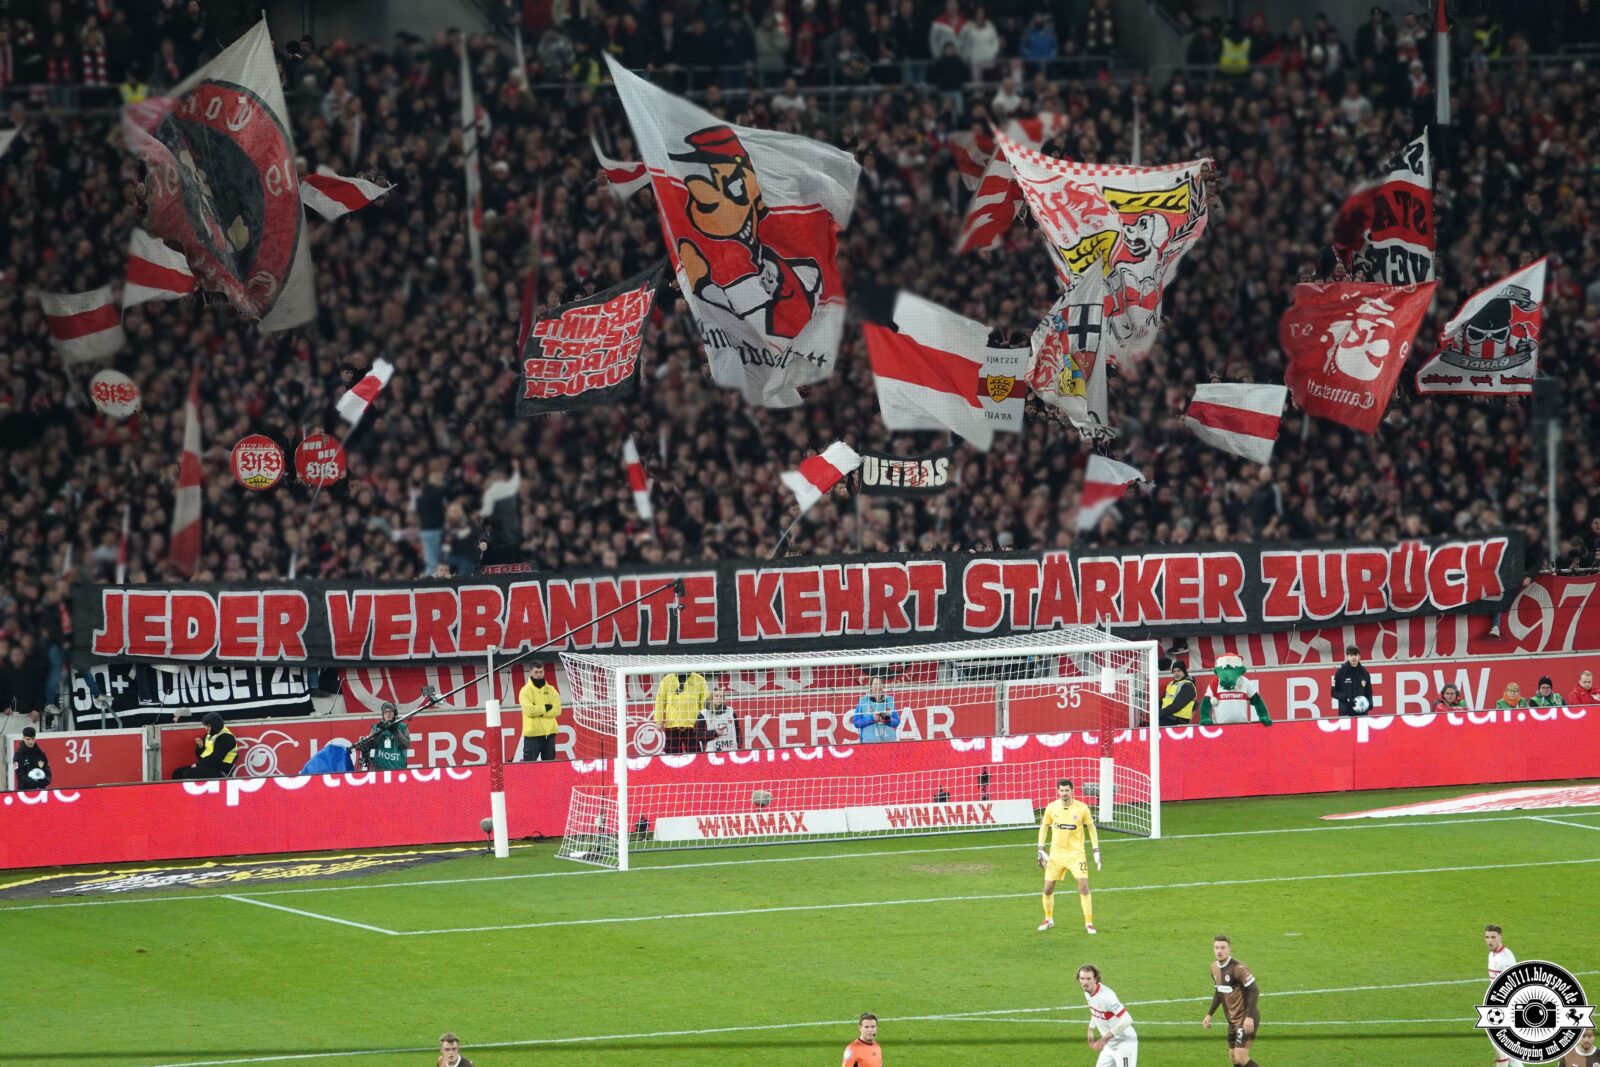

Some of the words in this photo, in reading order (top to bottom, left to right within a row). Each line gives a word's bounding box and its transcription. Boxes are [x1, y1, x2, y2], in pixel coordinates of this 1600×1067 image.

[863, 455, 949, 488] ULTRAS
[91, 588, 309, 661] JEDER
[324, 571, 719, 660] VERBANNTE
[735, 560, 947, 641] KEHRT
[962, 551, 1247, 632] STÄRKER
[1261, 537, 1509, 623] ZURÜCK
[1055, 685, 1081, 709] 35
[65, 738, 92, 764] 34
[378, 749, 400, 761] HOST
[696, 811, 808, 838] WINAMAX
[885, 802, 996, 828] WINAMAX
[1080, 861, 1087, 871] 22
[1236, 1027, 1244, 1040] 5
